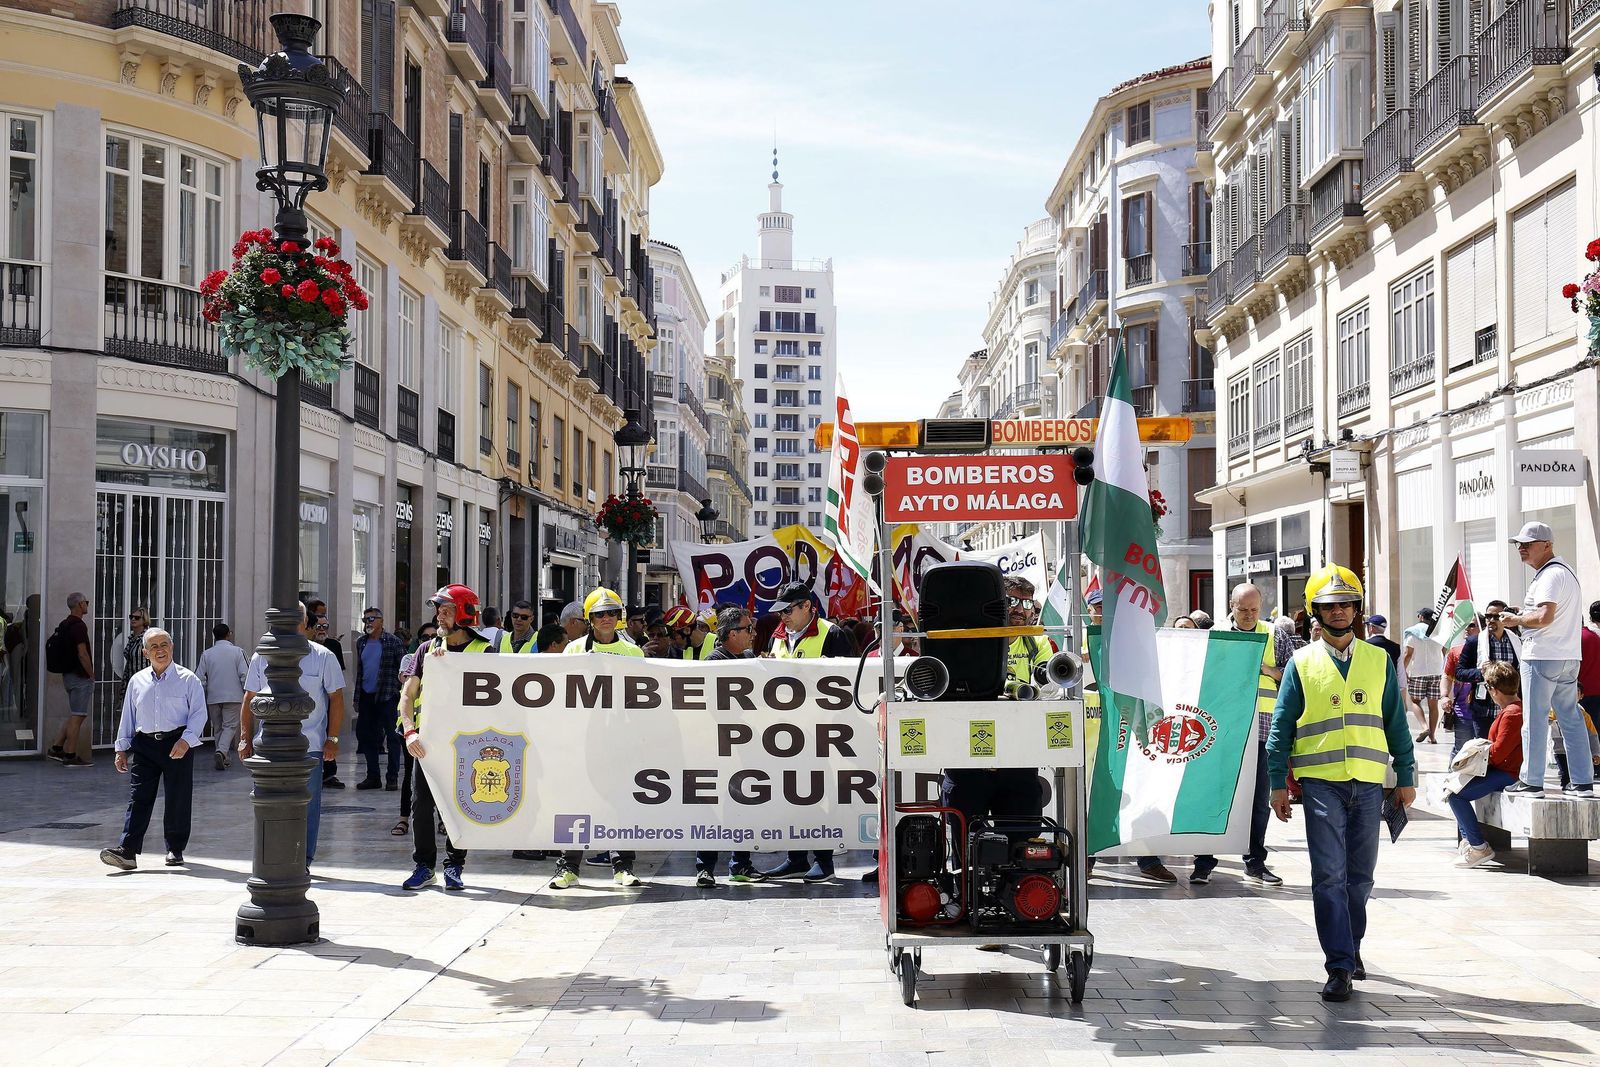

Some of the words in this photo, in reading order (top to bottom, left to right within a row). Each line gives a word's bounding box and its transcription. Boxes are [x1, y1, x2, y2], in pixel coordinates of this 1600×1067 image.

[992, 418, 1092, 442] BOMBEROS
[122, 443, 207, 471] OYSHO
[1521, 460, 1577, 472] PANDORA
[906, 464, 1055, 486] BOMBEROS
[1459, 471, 1495, 495] PANDORA
[898, 493, 960, 512] AYTO
[966, 490, 1064, 511] MÁLAGA
[998, 552, 1037, 574] Costa
[462, 671, 854, 711] BOMBEROS
[1175, 703, 1219, 732] SINDICATO
[468, 736, 514, 747] MALAGA
[717, 723, 858, 758] POR
[1170, 722, 1181, 748] SAB
[458, 790, 482, 820] CUERPO
[506, 759, 521, 813] BOMBEROS
[594, 825, 684, 840] Bomberos
[690, 825, 755, 844] Málaga
[760, 827, 783, 840] en
[789, 825, 843, 840] Lucha
